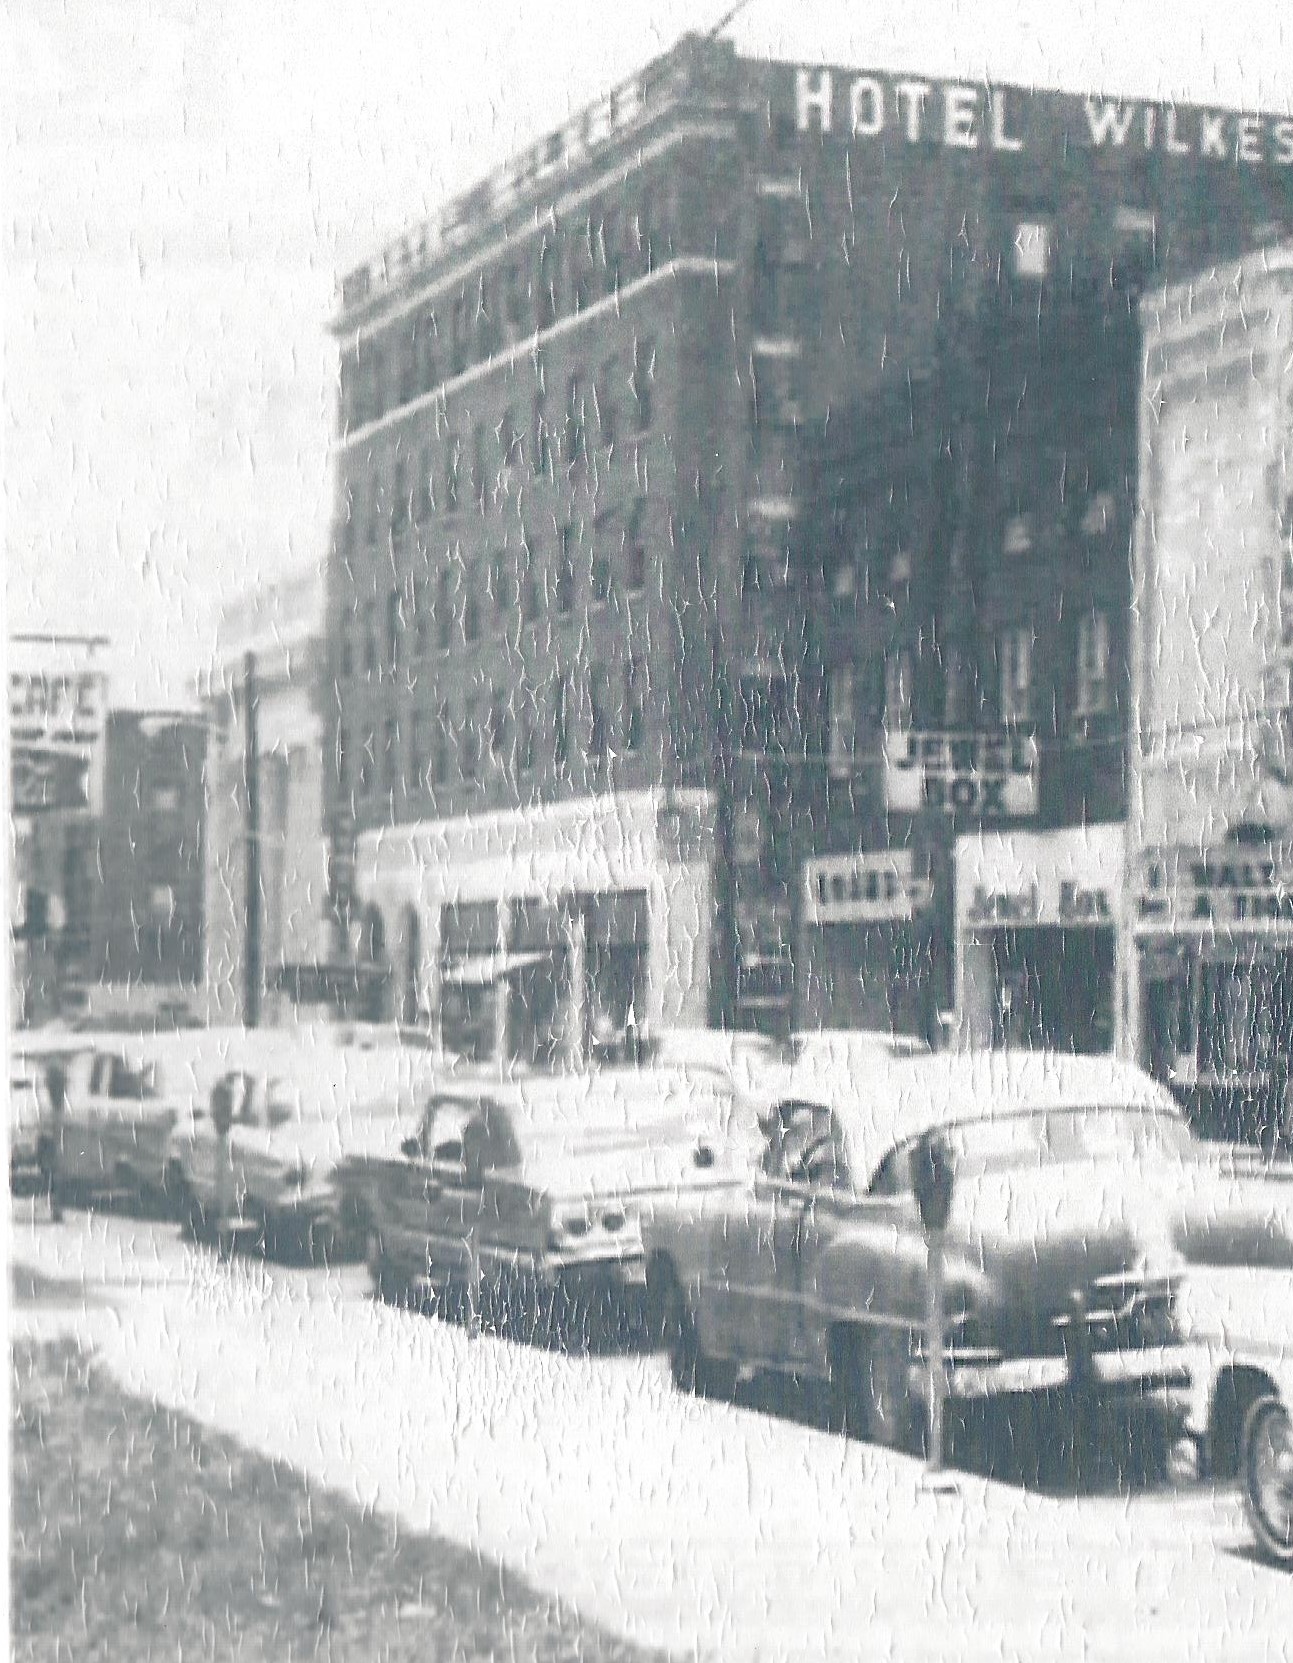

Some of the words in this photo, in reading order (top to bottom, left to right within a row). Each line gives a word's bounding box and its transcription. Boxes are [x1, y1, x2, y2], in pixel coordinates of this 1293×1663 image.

[796, 70, 1023, 152] HOTEL
[897, 738, 1032, 774] JEWEL
[923, 777, 1005, 814] BOX
